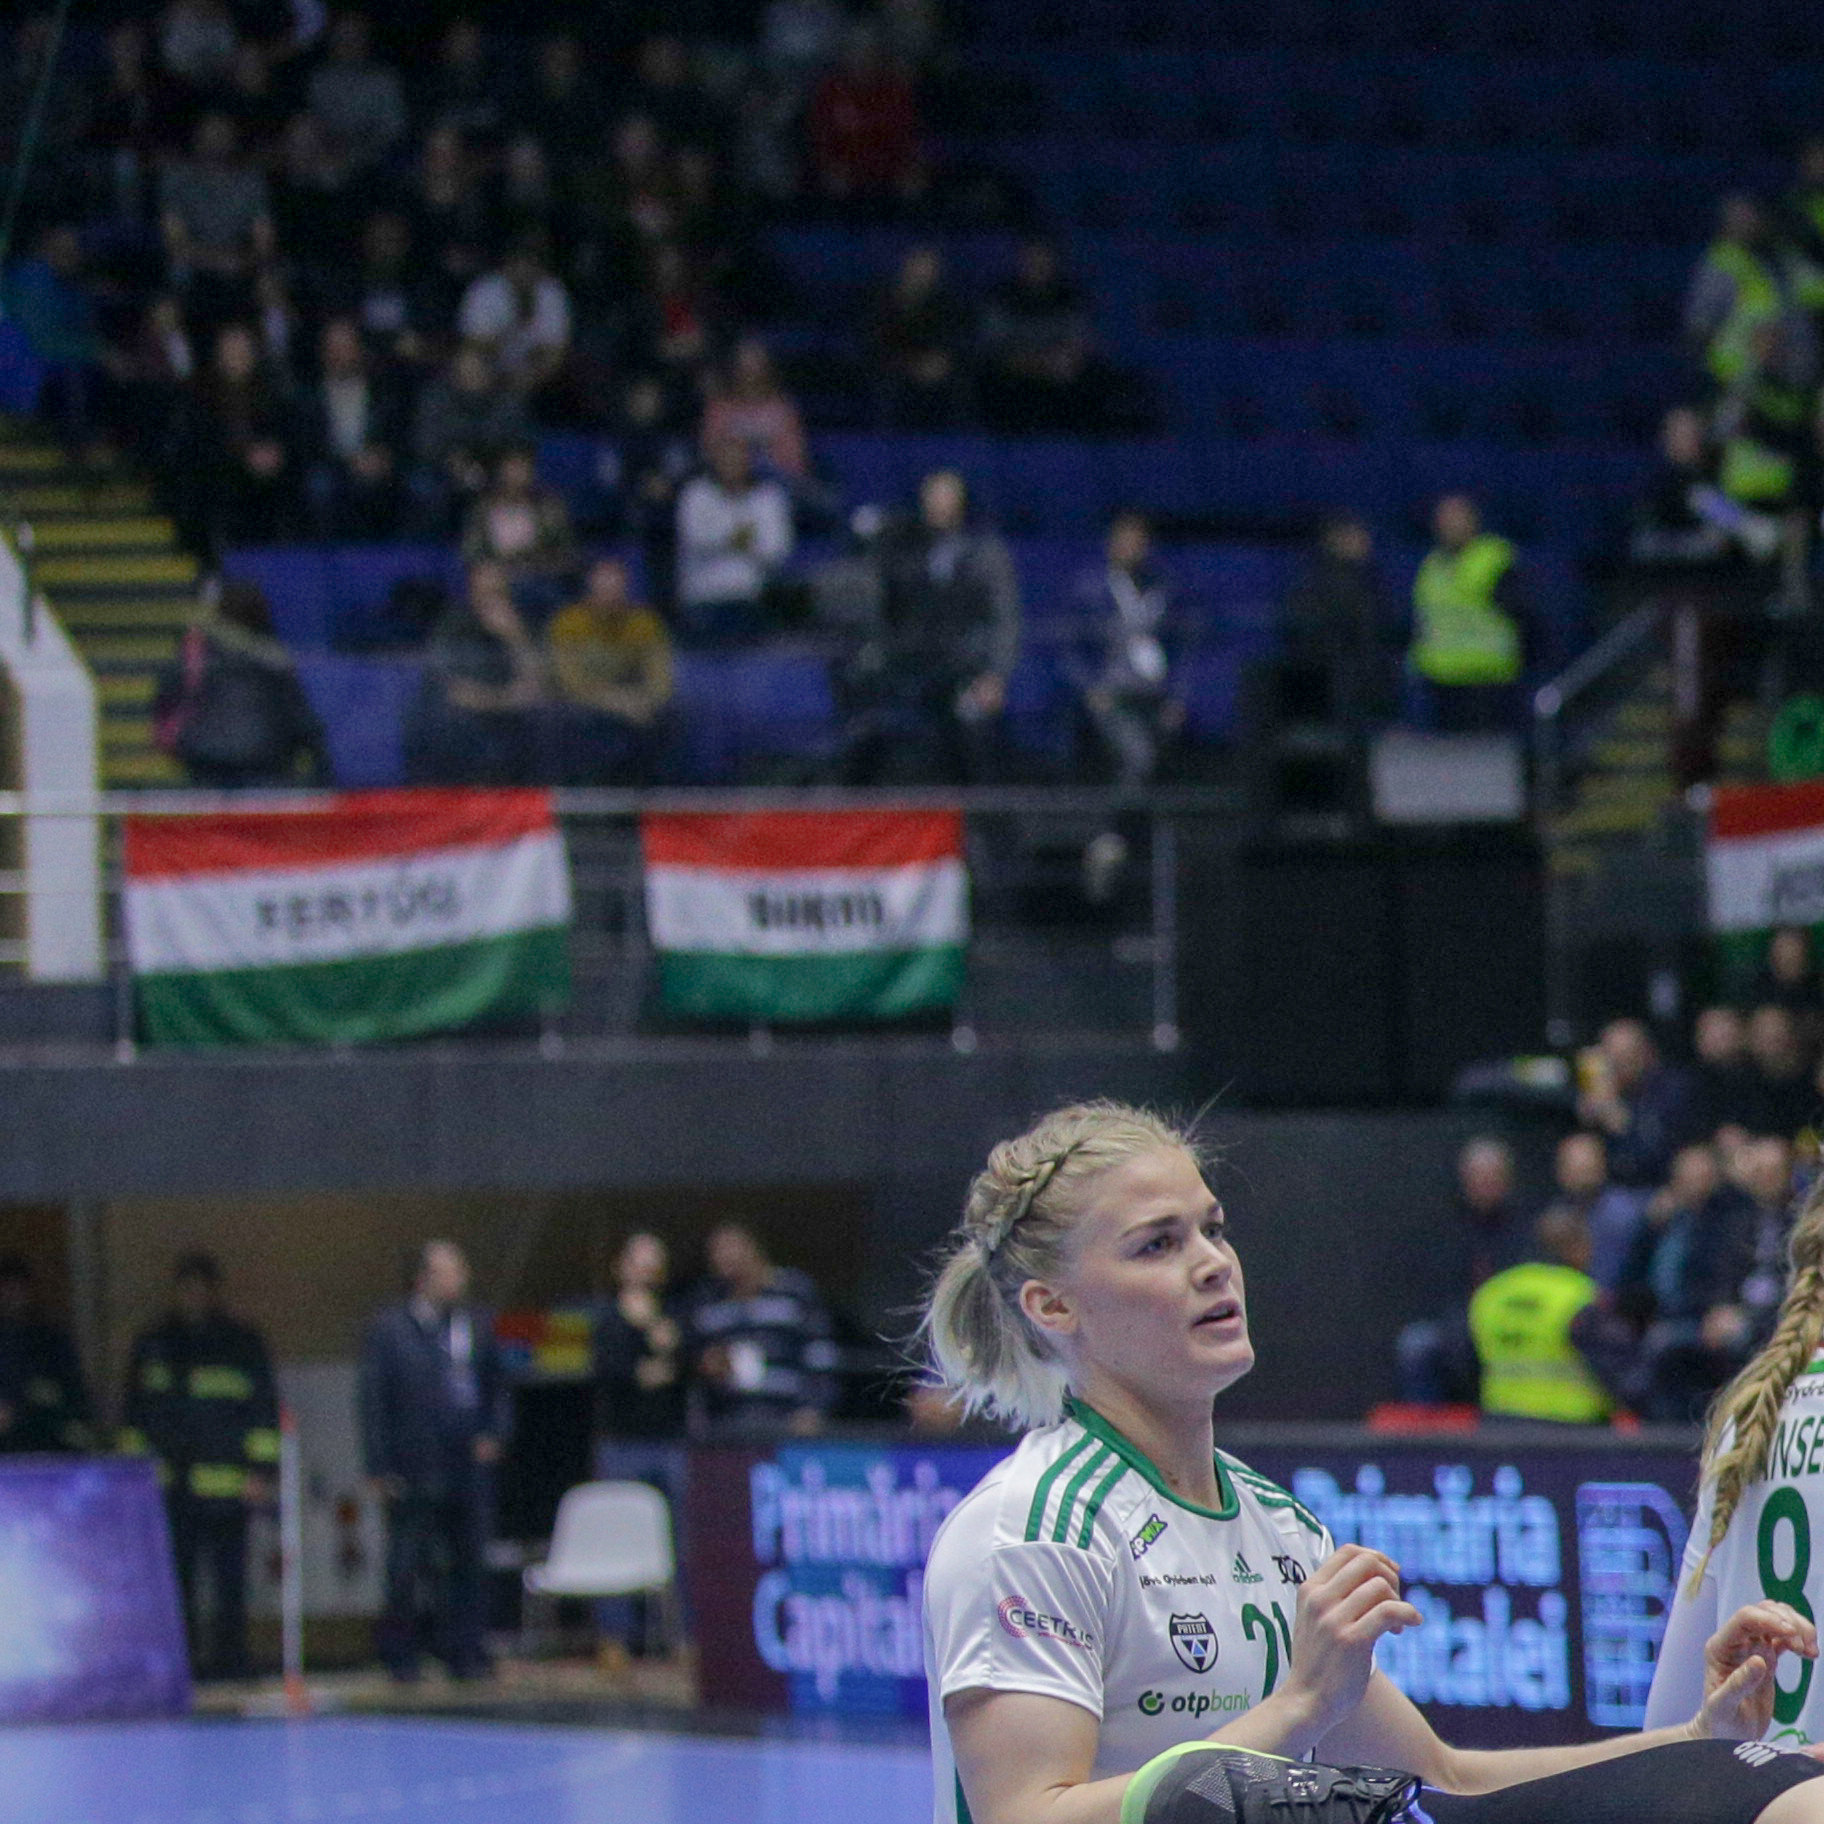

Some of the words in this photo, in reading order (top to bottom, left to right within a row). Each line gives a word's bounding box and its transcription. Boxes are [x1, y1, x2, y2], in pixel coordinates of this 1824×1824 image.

[754, 1568, 924, 1699] Capital
[1757, 1486, 1818, 1726] 8
[1171, 1688, 1251, 1718] otpbank
